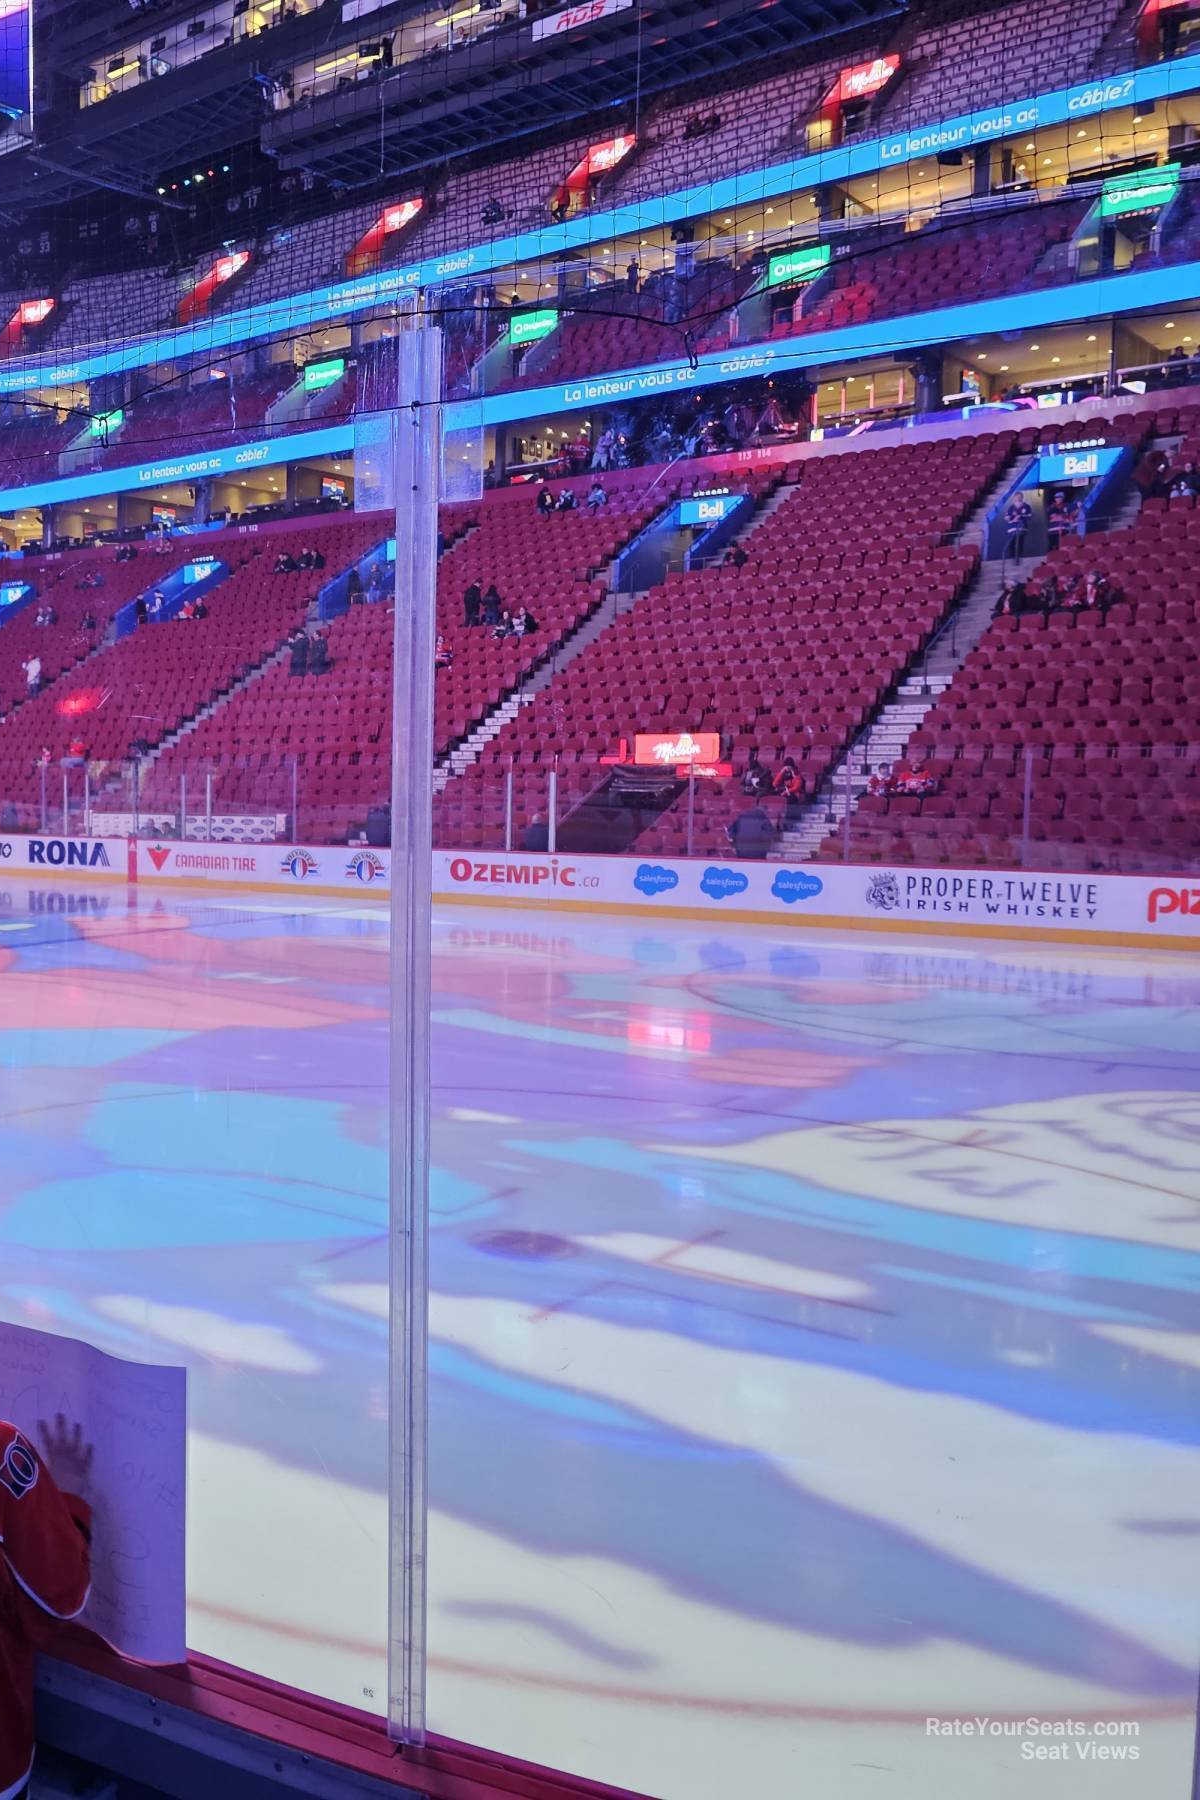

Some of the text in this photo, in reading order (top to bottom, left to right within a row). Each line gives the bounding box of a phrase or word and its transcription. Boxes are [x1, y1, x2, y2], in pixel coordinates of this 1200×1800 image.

[881, 80, 1135, 158] La lenteur vous ac câble?
[406, 271, 421, 283] ac
[565, 387, 582, 402] La
[584, 375, 636, 399] lenteur
[638, 371, 673, 388] vous
[676, 367, 696, 381] ac
[139, 470, 151, 481] La
[152, 465, 184, 479] lenteur
[185, 461, 208, 473] vous
[209, 458, 221, 468] ac
[1063, 454, 1098, 476] Bell
[698, 501, 725, 519] Bell
[651, 742, 701, 762] Molson
[29, 840, 110, 867] RONA
[175, 854, 256, 871] CANADIAN TIRE
[639, 875, 675, 885] salesforce
[706, 877, 745, 888] salesforce
[778, 880, 819, 892] salesforce
[906, 875, 1097, 905] PROPER TWELVE
[906, 898, 1097, 920] IRISH WHISKEY
